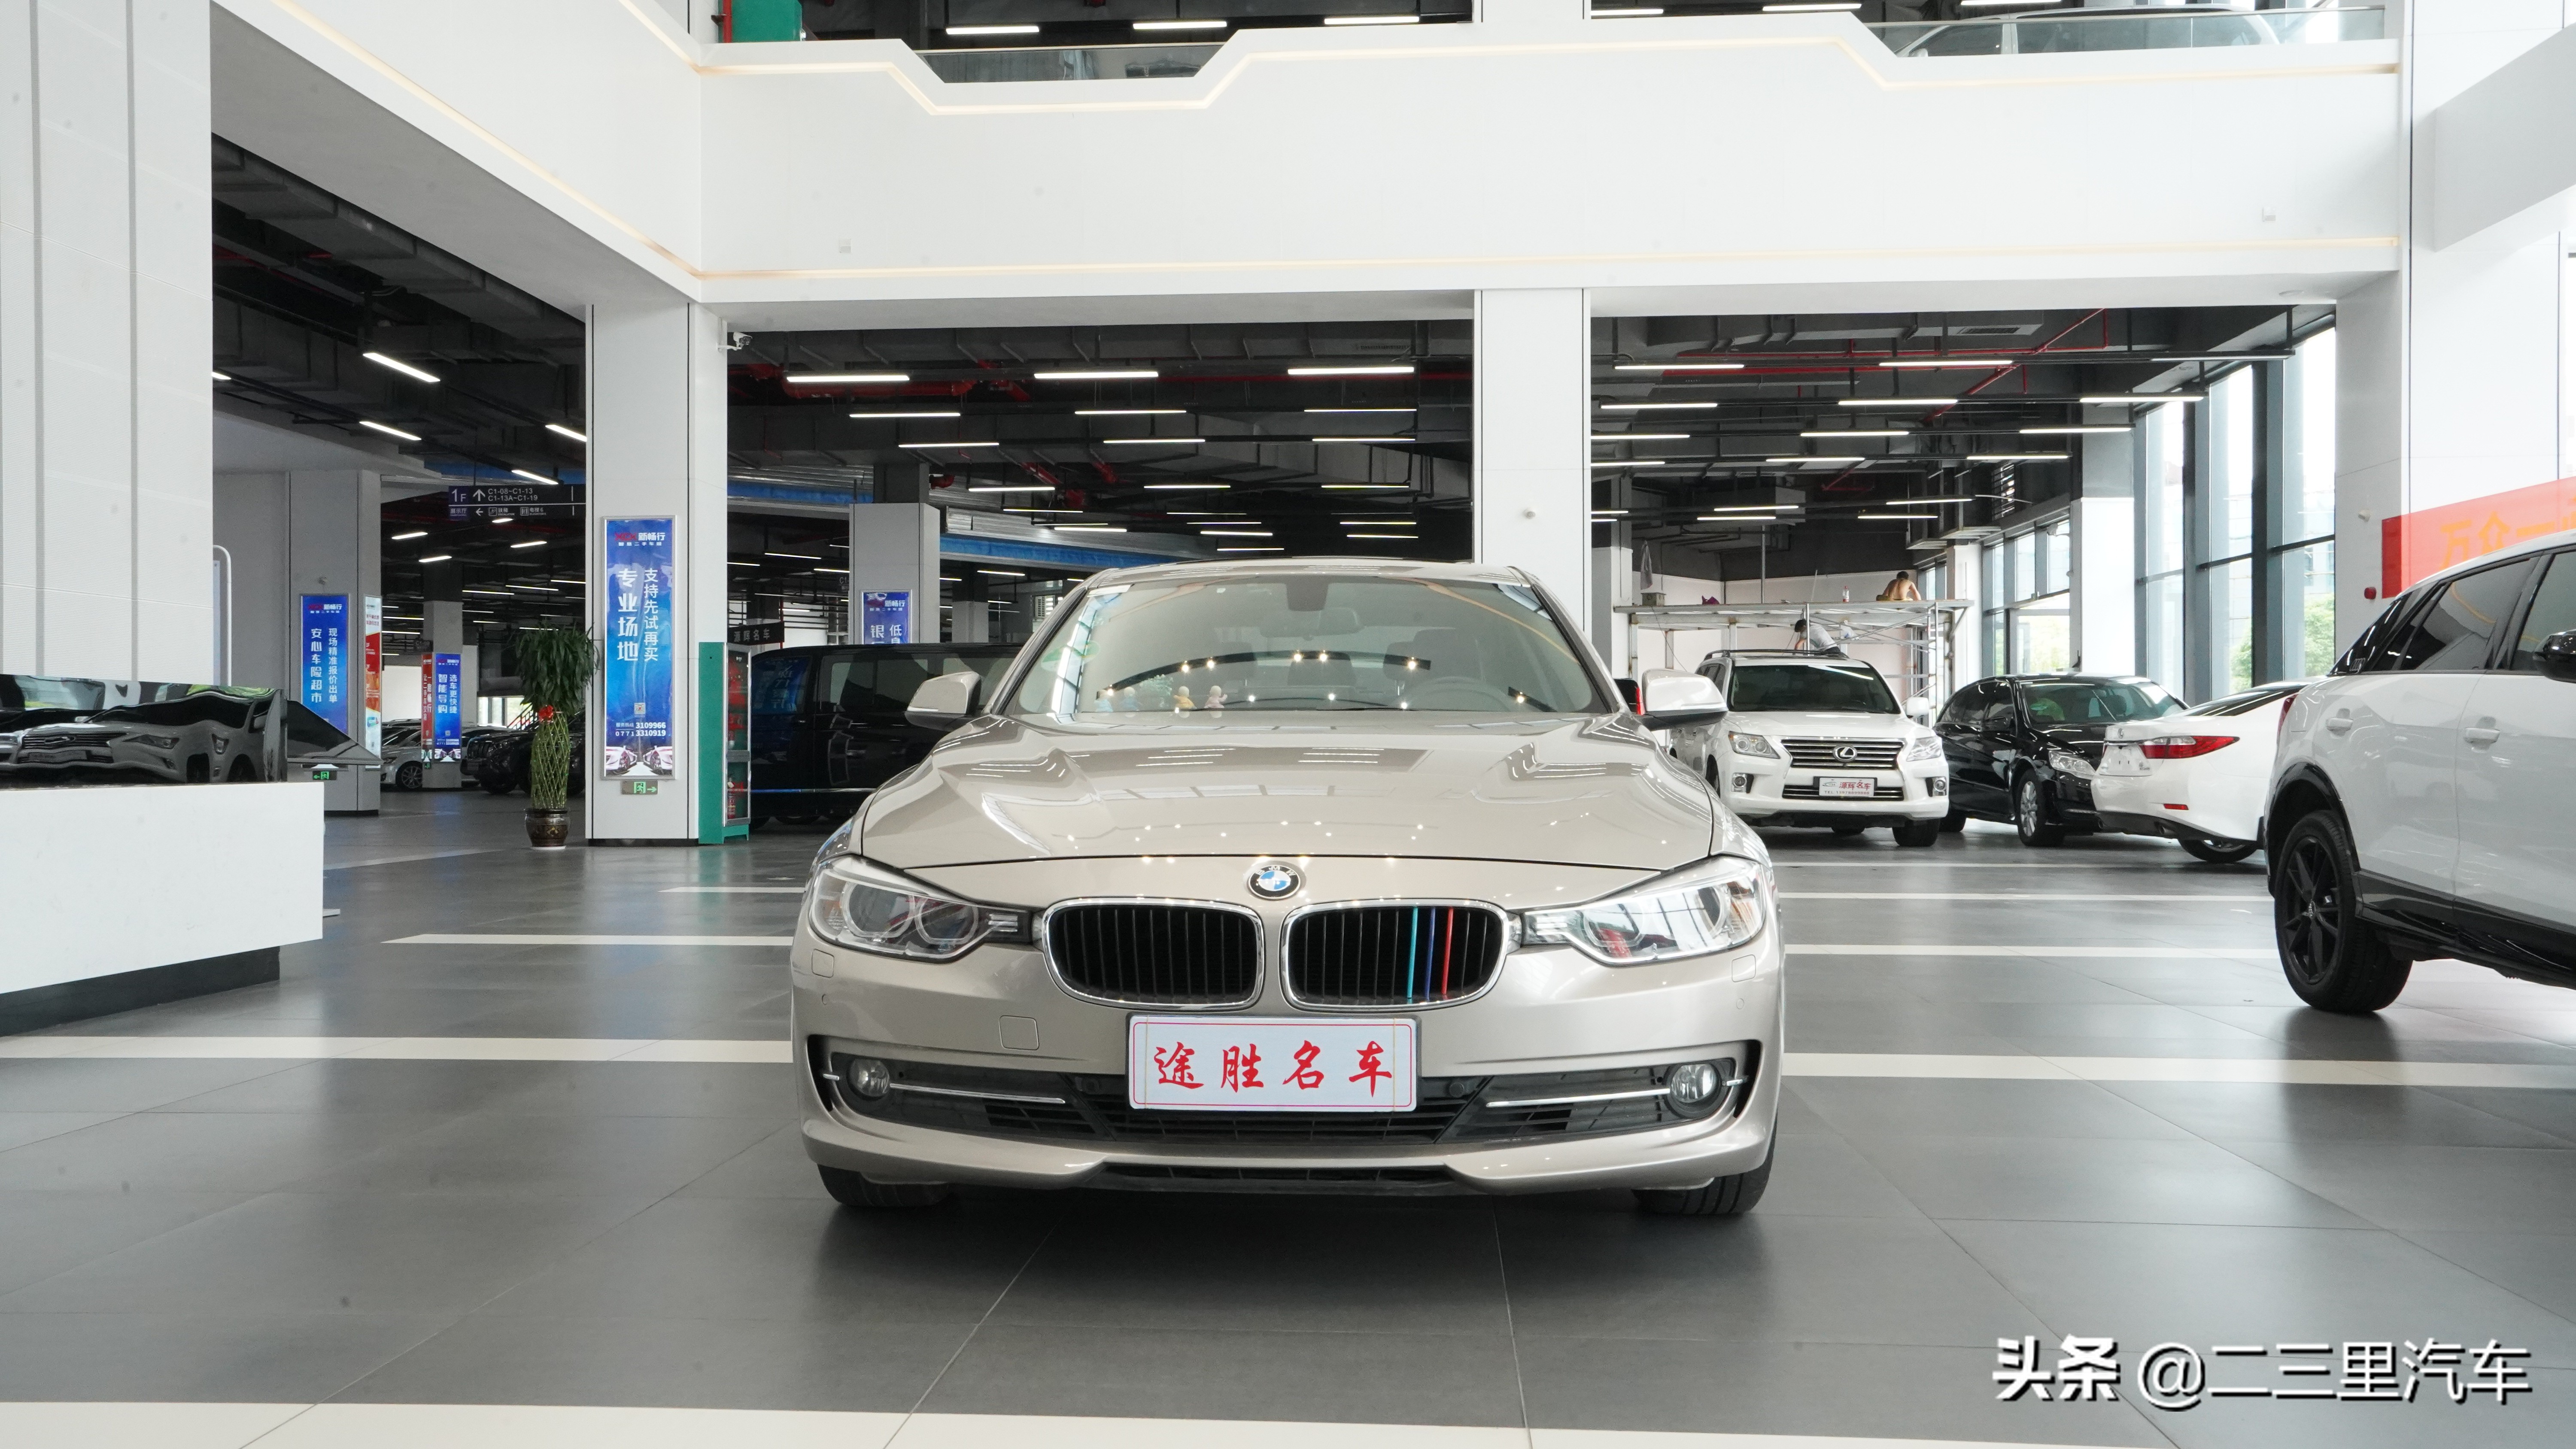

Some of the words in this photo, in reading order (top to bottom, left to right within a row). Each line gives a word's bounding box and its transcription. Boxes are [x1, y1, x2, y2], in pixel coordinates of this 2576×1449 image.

[638, 532, 665, 540] 新畅行
[617, 568, 638, 661] 专业场地
[644, 568, 659, 661] 支持先试再买
[311, 628, 322, 703] 安心车险超市
[328, 628, 337, 703] 现场精准报价出单
[438, 674, 447, 713] 智能导购
[450, 674, 458, 713] 选车更快捷
[1255, 865, 1296, 876] BMW
[1154, 1040, 1392, 1097] 途胜名车
